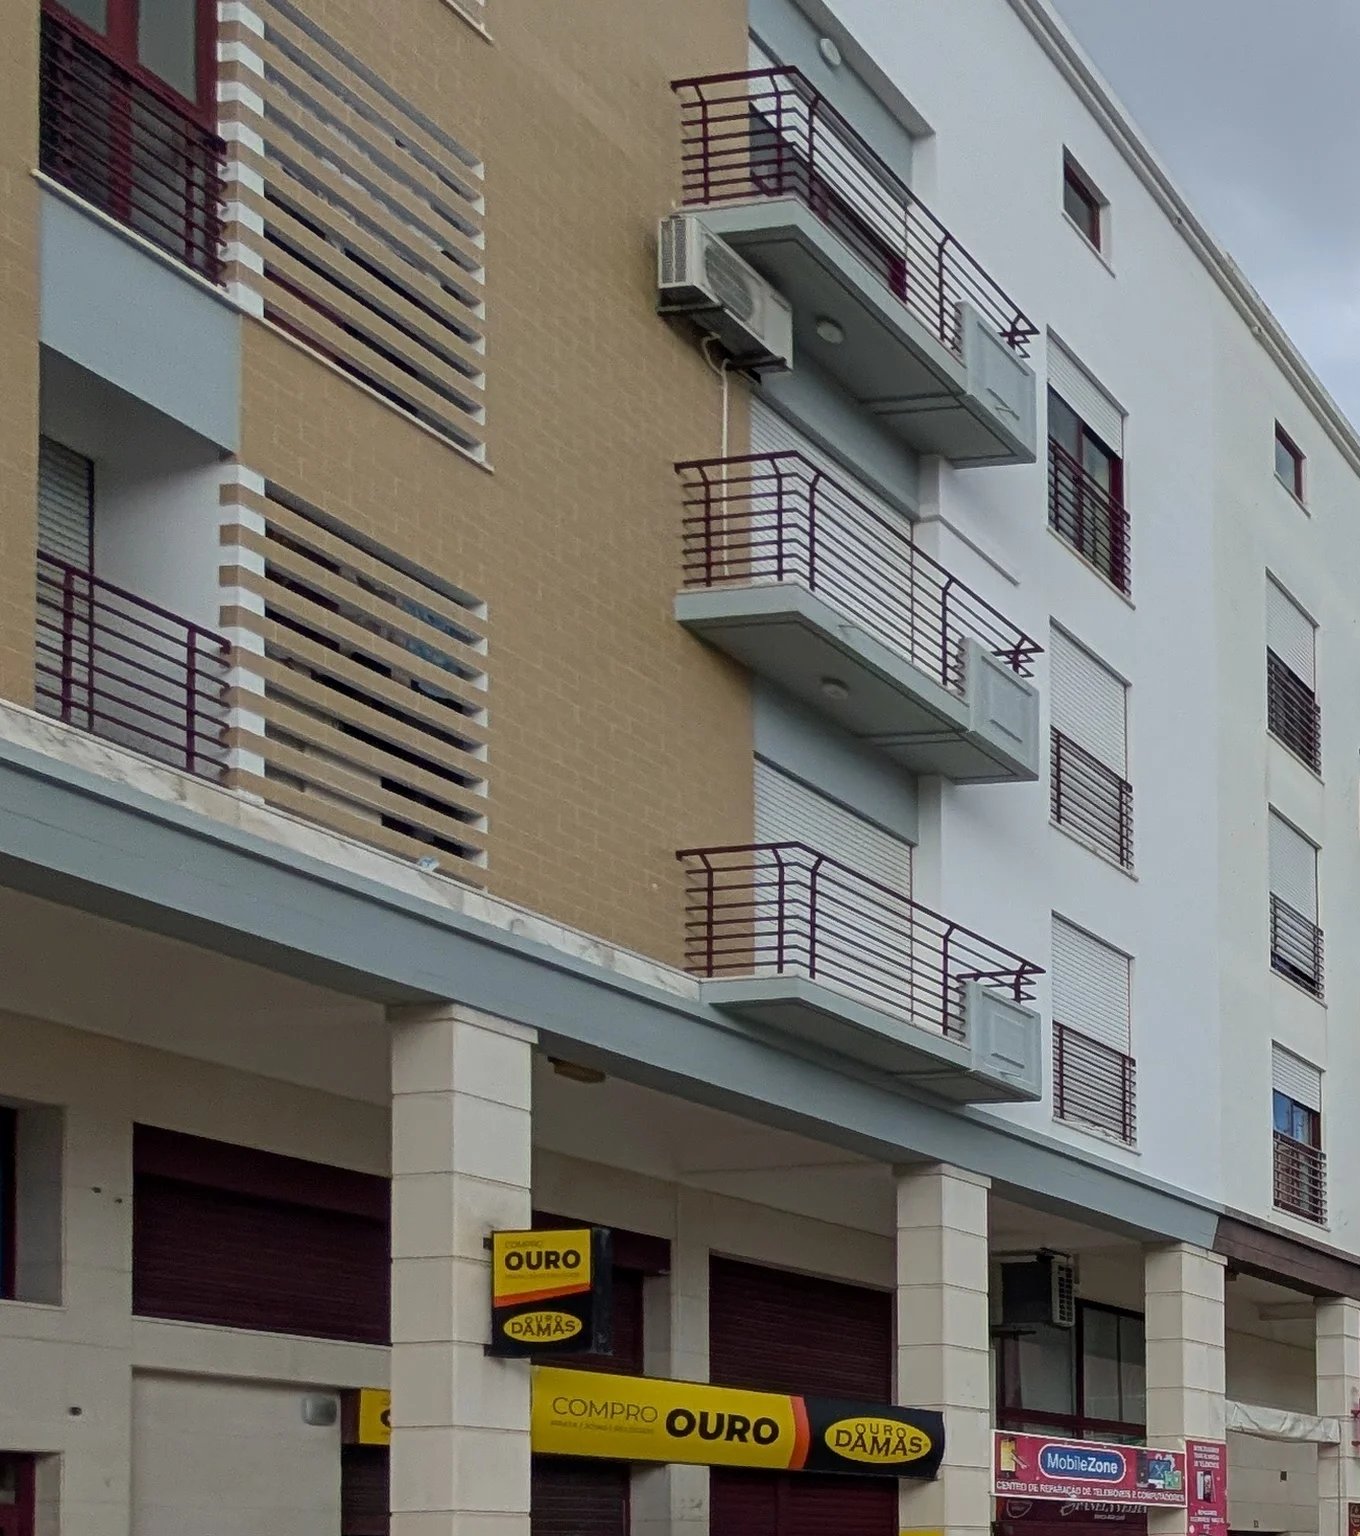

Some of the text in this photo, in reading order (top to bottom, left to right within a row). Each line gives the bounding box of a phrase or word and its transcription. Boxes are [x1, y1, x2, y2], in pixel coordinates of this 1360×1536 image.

[504, 1249, 581, 1271] OURO
[511, 1320, 576, 1337] DAMAS
[524, 1315, 563, 1324] OURO
[552, 1397, 780, 1445] COMPRO OURO
[855, 1423, 907, 1438] OURO
[835, 1429, 922, 1457] DAMAS
[1047, 1453, 1118, 1474] MobileZone
[997, 1481, 1027, 1491] CENTRO
[1029, 1483, 1039, 1493] DE
[1040, 1484, 1081, 1496] REPARAÇÃO
[1082, 1487, 1092, 1496] DE
[1138, 1491, 1185, 1502] COMPUTADORES
